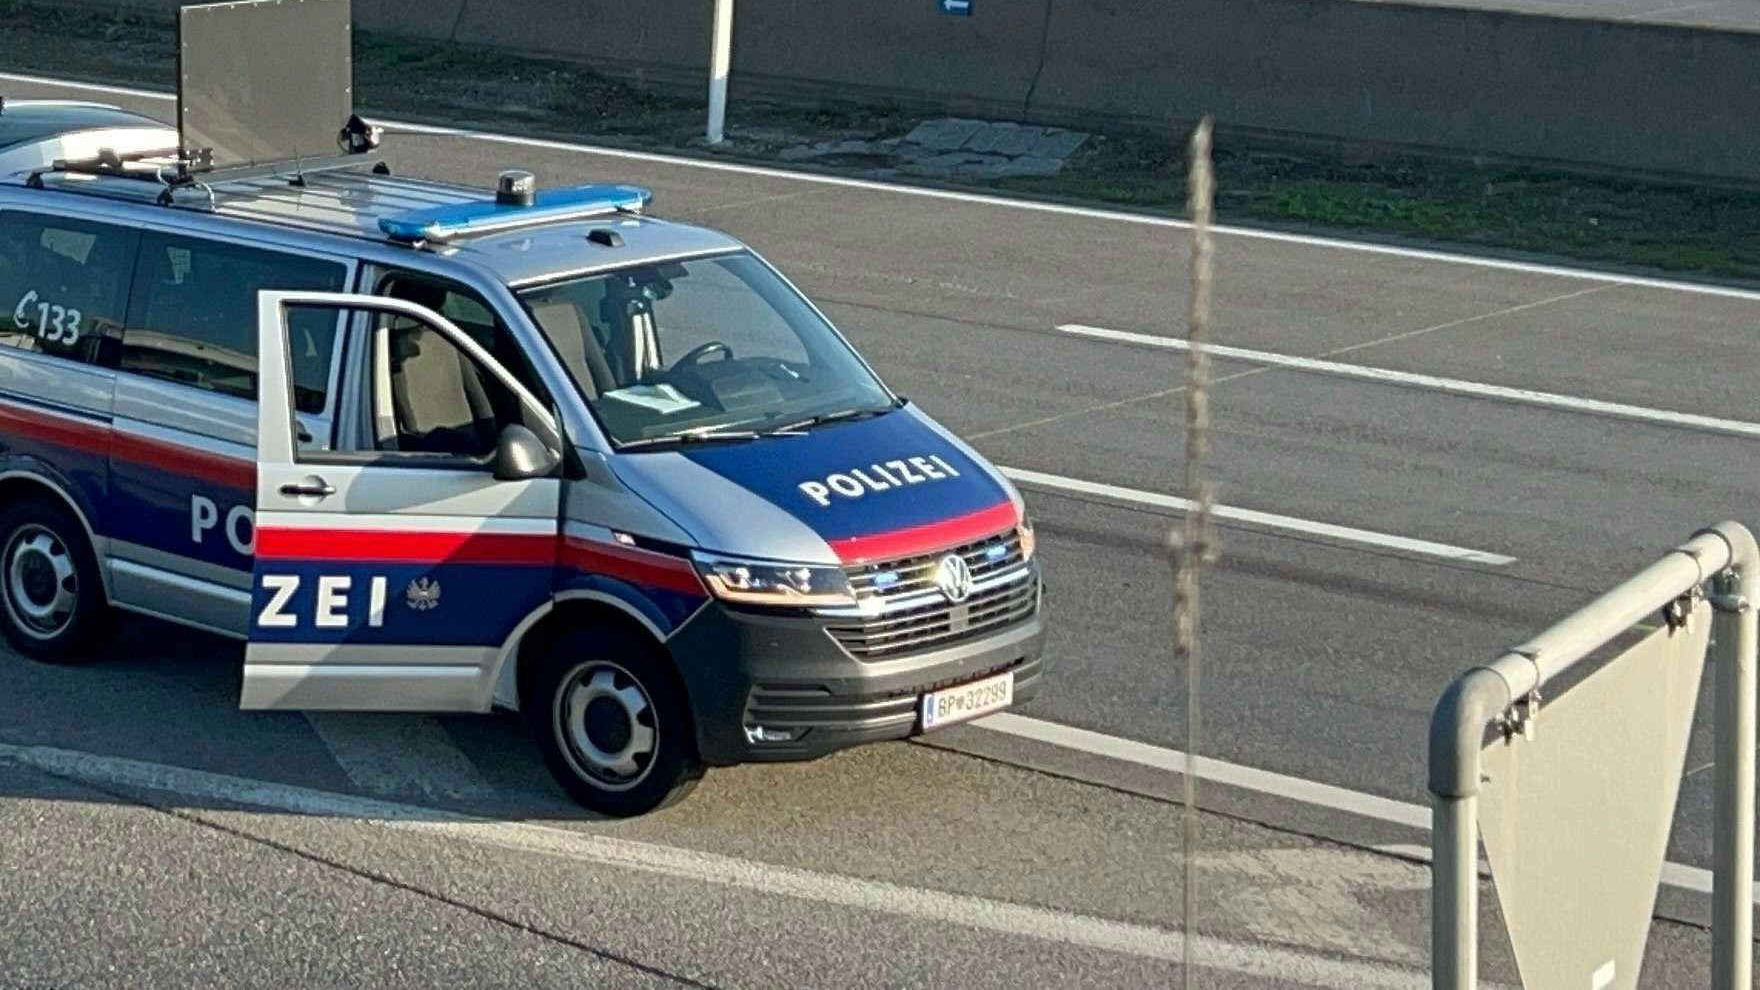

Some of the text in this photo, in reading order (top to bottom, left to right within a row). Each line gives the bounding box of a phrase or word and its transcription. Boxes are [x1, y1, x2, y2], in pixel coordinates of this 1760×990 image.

[797, 454, 961, 507] POLIZEI
[191, 493, 256, 556] PO
[256, 574, 389, 628] ZEI
